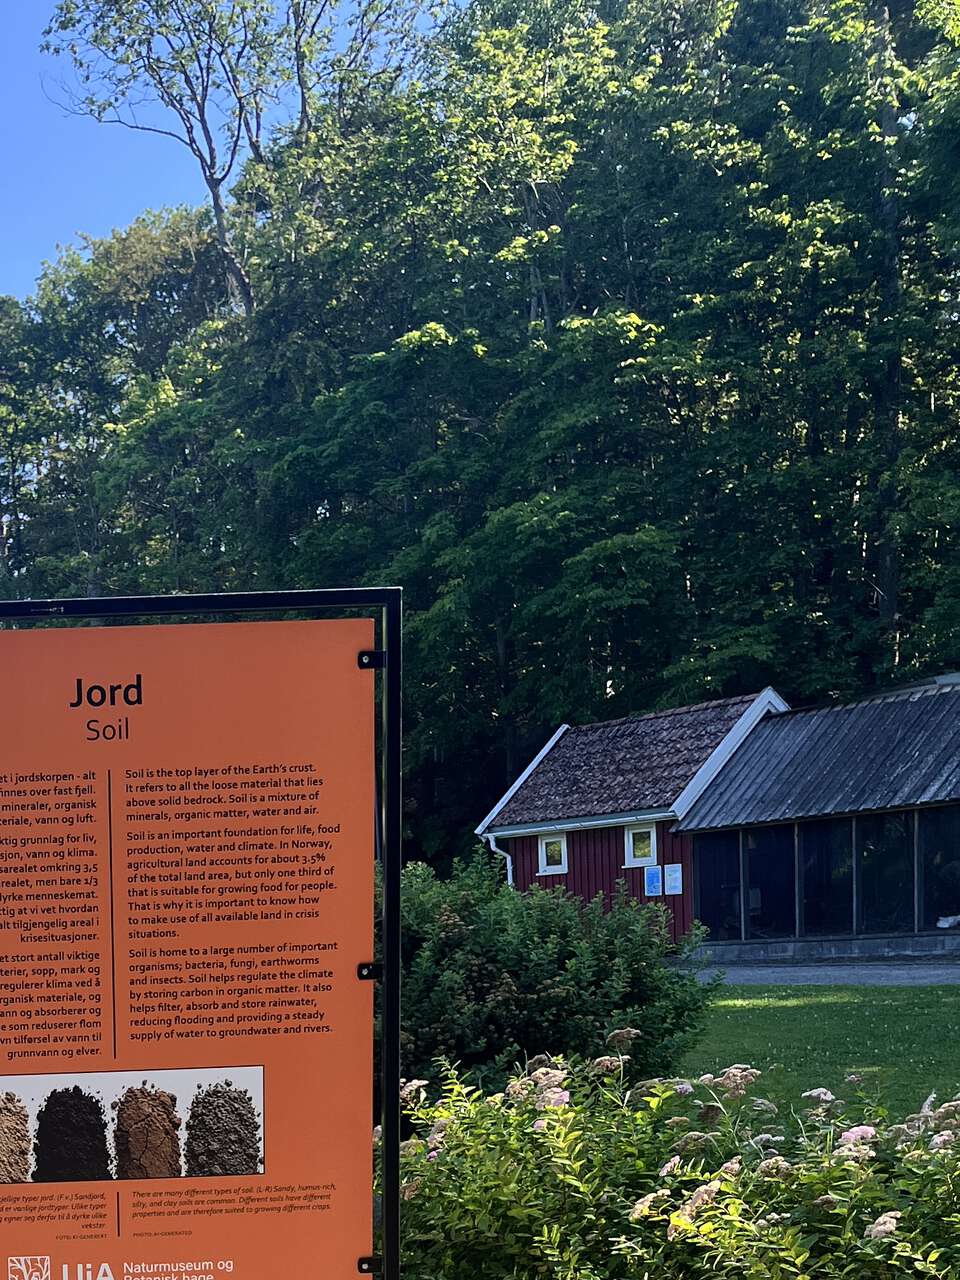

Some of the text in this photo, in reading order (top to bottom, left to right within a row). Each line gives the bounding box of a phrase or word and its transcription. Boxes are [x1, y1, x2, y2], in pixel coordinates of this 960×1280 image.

[70, 674, 142, 708] Jord
[86, 717, 128, 740] Soil
[10, 773, 12, 782] i
[15, 772, 74, 785] jordskorpen
[82, 770, 96, 780] alt
[125, 768, 144, 778] Soil
[145, 768, 154, 778] is
[156, 768, 173, 777] the
[174, 768, 192, 779] top
[194, 766, 219, 778] layer
[220, 765, 231, 775] of
[233, 765, 252, 775] the
[288, 763, 316, 772] crust.
[53, 785, 73, 795] fast
[74, 784, 95, 796] fjell.
[125, 776, 323, 792] It refers to all the loose material that lies
[1, 801, 51, 812] mineraler,
[54, 799, 96, 812] organisk
[125, 797, 156, 807] above
[158, 795, 181, 806] solid
[183, 794, 227, 805] bedrock.
[228, 793, 247, 803] Soil
[249, 793, 257, 802] is
[267, 791, 306, 802] mixture
[308, 790, 319, 800] of
[61, 816, 74, 826] og
[76, 812, 96, 823] luft.
[126, 805, 319, 822] minerals, organic matter, water and air.
[19, 834, 64, 847] grunnlag
[66, 833, 80, 843] for
[82, 832, 96, 844] liv,
[52, 850, 65, 860] og
[67, 847, 97, 856] klima.
[39, 862, 81, 873] omkring
[83, 863, 98, 872] 3,5
[59, 876, 81, 885] bare
[83, 875, 98, 886] 1/3
[128, 928, 179, 938] situations.
[128, 947, 147, 958] Soil
[149, 948, 157, 957] is
[159, 948, 187, 956] home
[189, 947, 200, 955] to
[210, 945, 234, 957] large
[236, 943, 275, 953] number
[276, 942, 288, 952] of
[288, 942, 338, 953] important
[128, 956, 319, 974] organisms; bacteria, fungi, earthworms
[129, 997, 316, 1014] helps filter, absorb and store rainwater,
[130, 1016, 172, 1027] reducing
[174, 1014, 214, 1026] flooding
[216, 1013, 234, 1023] and
[236, 1011, 282, 1024] providing
[292, 1009, 324, 1021] steady
[7, 1046, 101, 1060] grunnvann og elver.
[123, 1260, 233, 1273] Naturmuseum og
